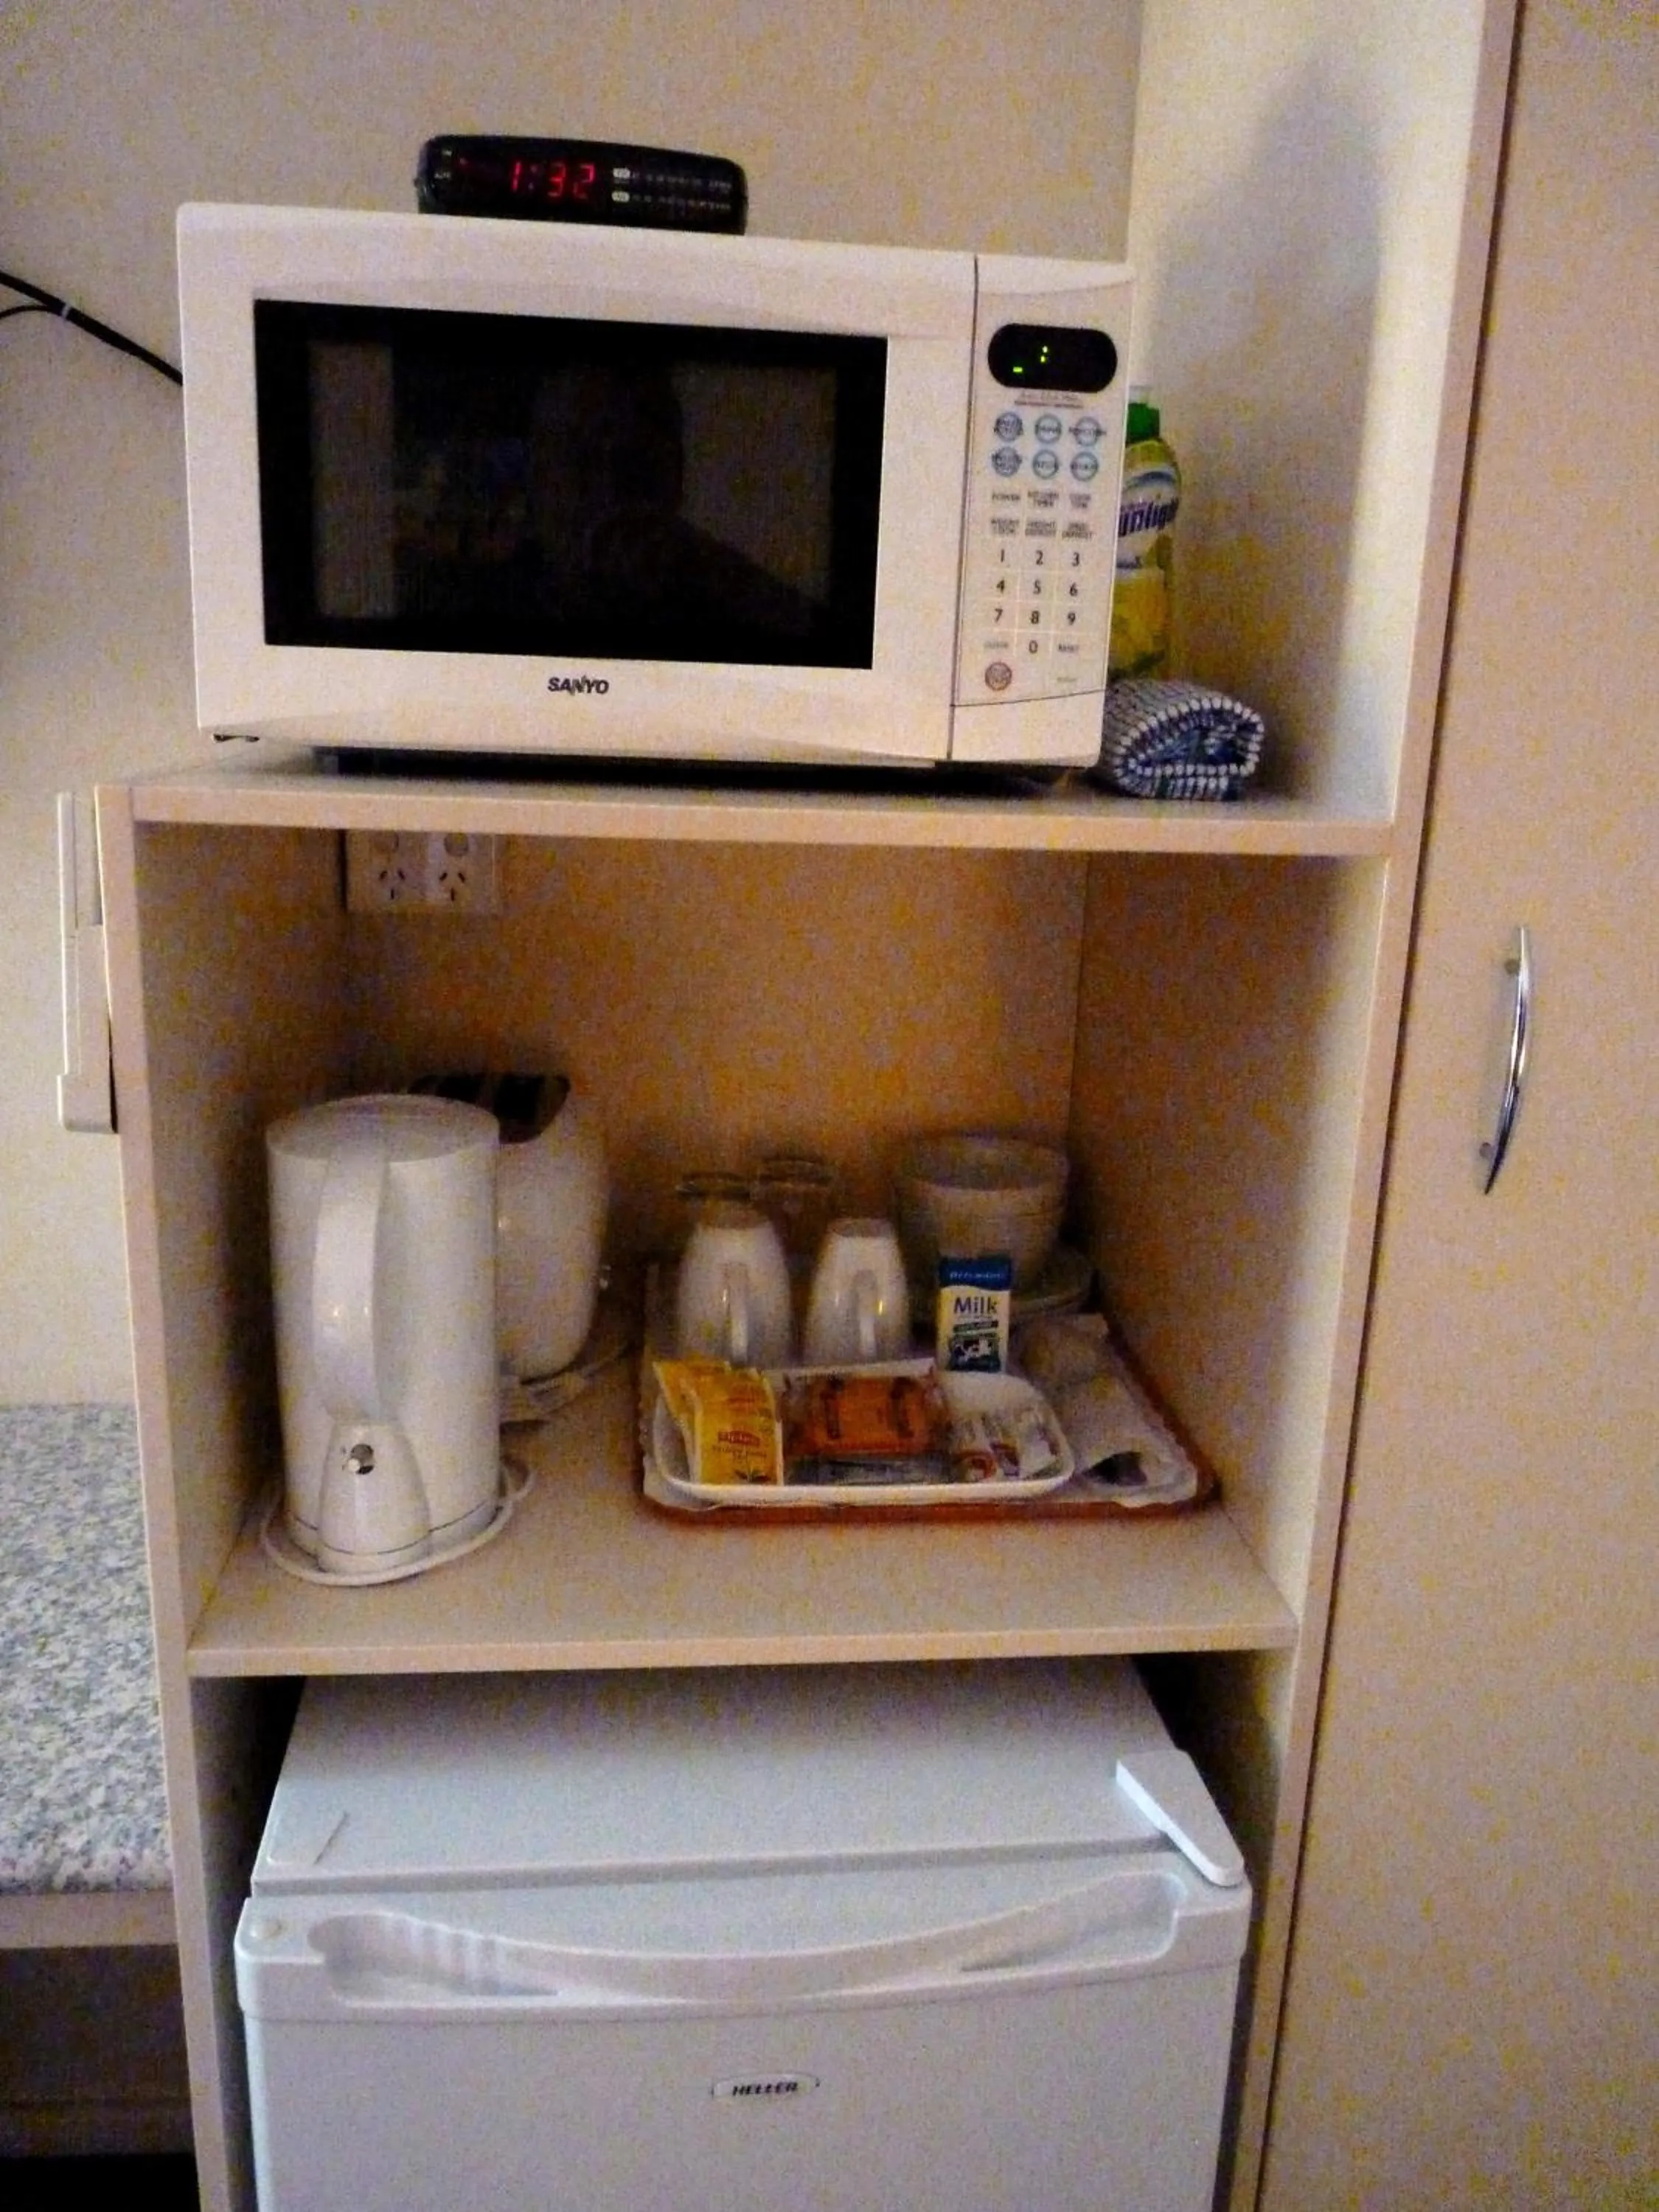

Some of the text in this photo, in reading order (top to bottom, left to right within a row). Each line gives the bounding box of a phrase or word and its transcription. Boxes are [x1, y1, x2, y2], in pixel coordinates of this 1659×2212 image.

[511, 161, 596, 199] 1:32
[999, 549, 1005, 563] 1
[1035, 550, 1044, 566] 2
[1072, 552, 1080, 567] 3
[996, 580, 1006, 594] 4
[1033, 580, 1042, 595] 5
[1069, 583, 1078, 597] 6
[994, 608, 1004, 623] 7
[1030, 610, 1040, 625] 8
[1067, 612, 1077, 626] 9
[547, 675, 611, 696] SANYO
[953, 1295, 998, 1315] Milk
[731, 2081, 799, 2097] HELLER
